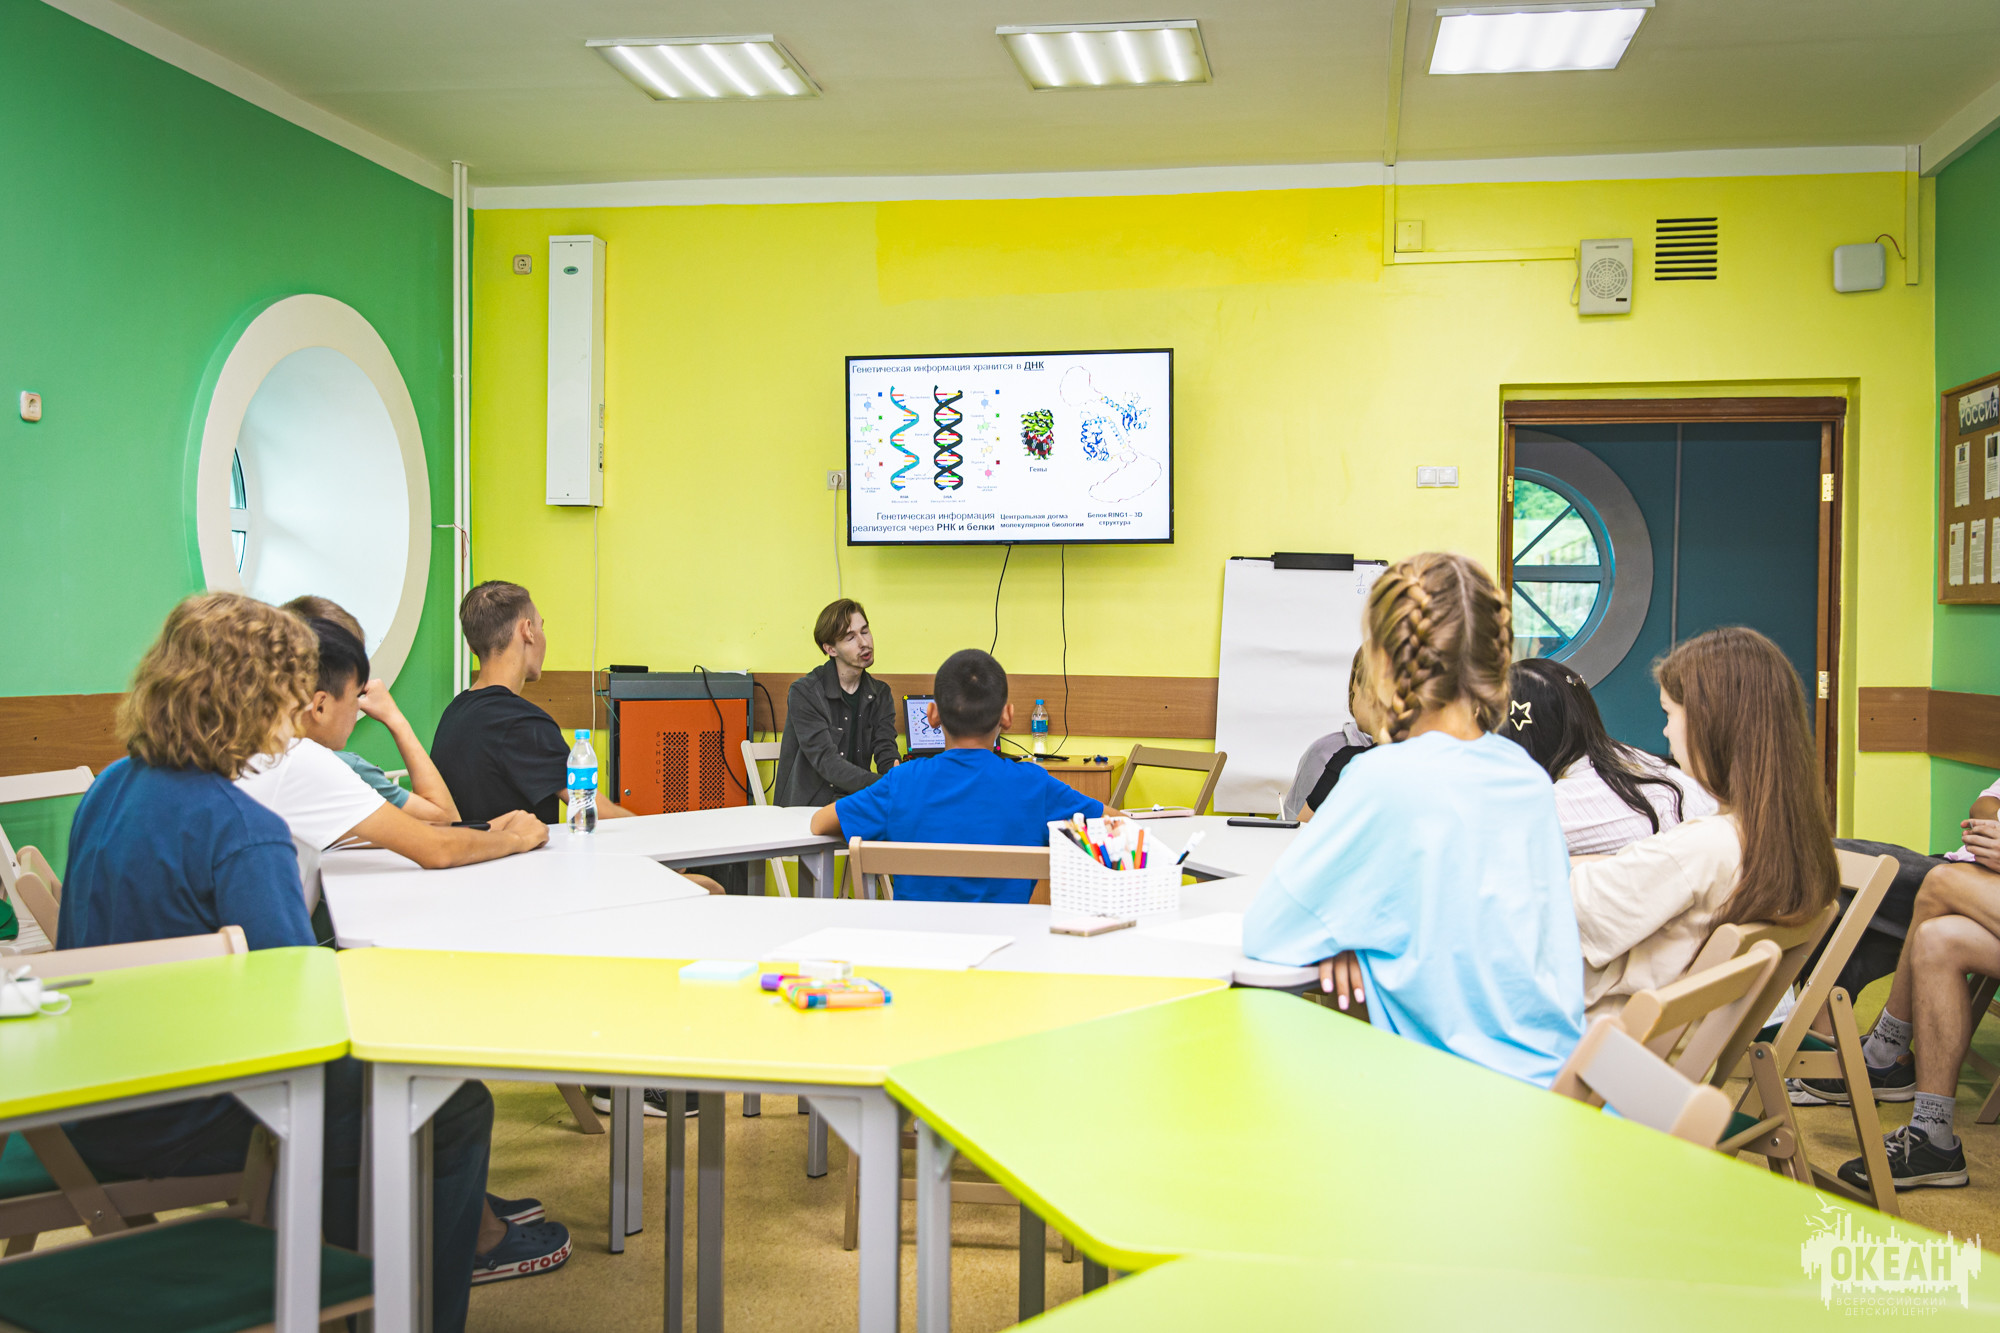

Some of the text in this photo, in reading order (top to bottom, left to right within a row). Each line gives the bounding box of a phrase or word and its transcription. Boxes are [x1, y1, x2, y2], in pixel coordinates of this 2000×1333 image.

[852, 365, 911, 374] Генетическая
[913, 364, 971, 375] информация
[973, 363, 1013, 373] хранится
[1023, 361, 1044, 371] ДНК
[1960, 399, 1998, 428] РОССИЯ
[876, 512, 995, 521] Генетическая информация
[1000, 513, 1046, 521] Центральная
[852, 524, 906, 533] реализуется
[908, 524, 935, 533] через
[936, 523, 956, 531] РНК
[966, 523, 995, 531] белки
[518, 1246, 569, 1273] crocs
